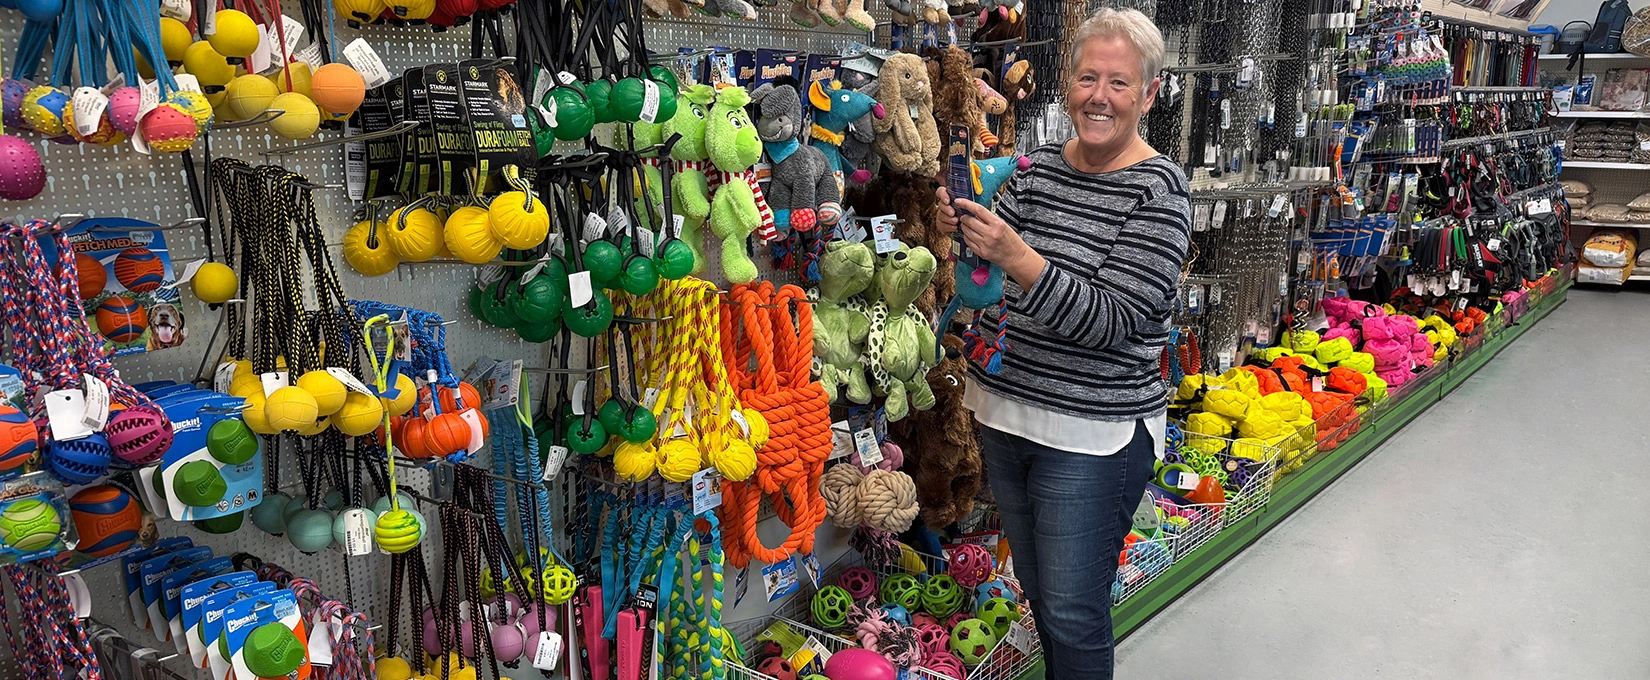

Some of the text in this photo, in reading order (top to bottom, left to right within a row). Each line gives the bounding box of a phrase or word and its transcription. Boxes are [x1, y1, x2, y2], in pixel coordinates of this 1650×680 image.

[464, 80, 489, 88] STARMARK
[475, 130, 519, 148] DURAFOAM
[519, 138, 531, 147] BALL
[72, 239, 106, 252] FETCH
[963, 536, 982, 544] KONG
[227, 612, 258, 633] Chuckit!
